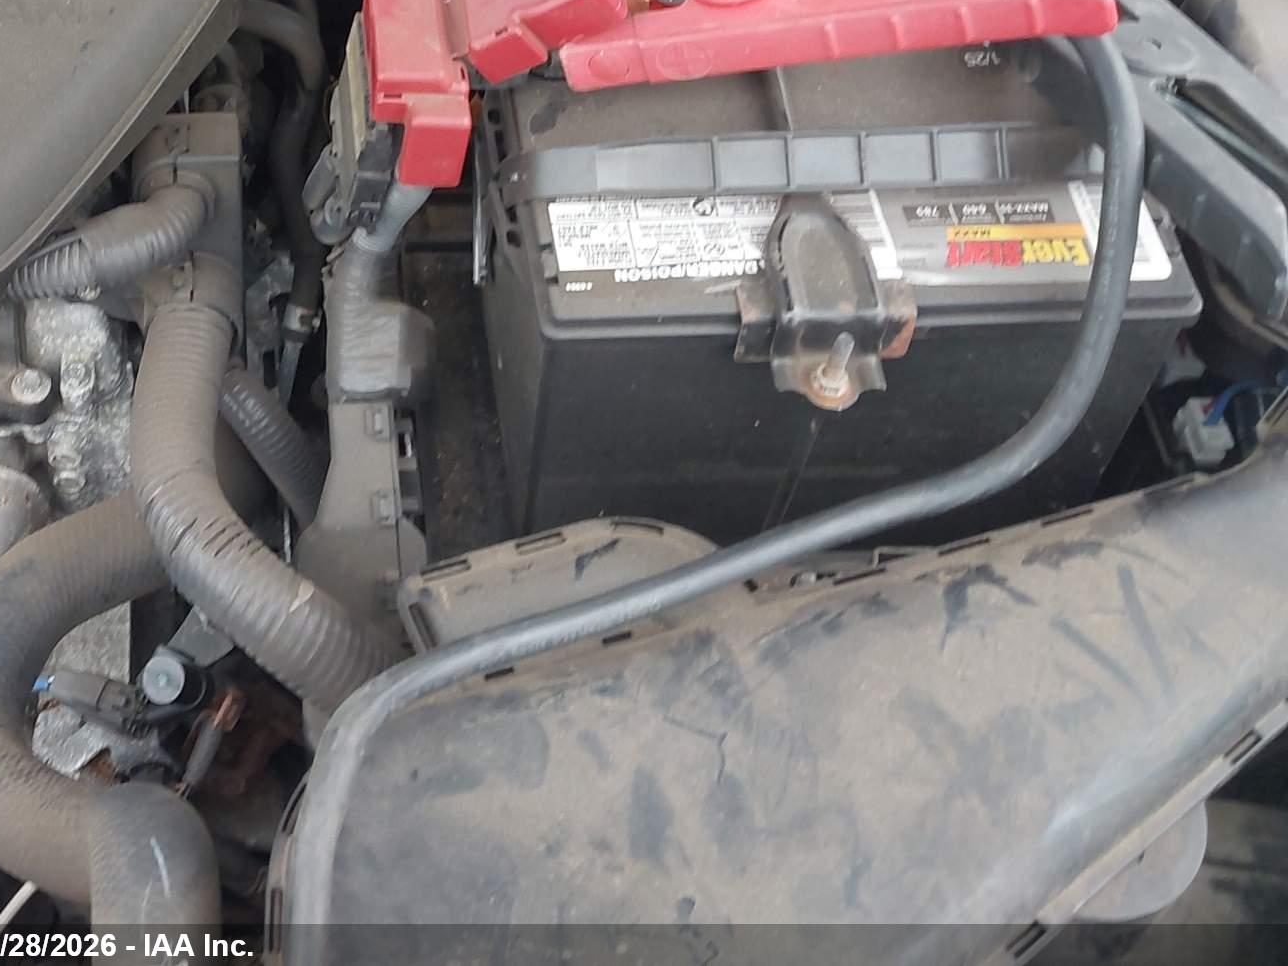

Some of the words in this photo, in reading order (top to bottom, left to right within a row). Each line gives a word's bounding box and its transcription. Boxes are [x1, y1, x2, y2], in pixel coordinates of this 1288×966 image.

[963, 50, 1001, 68] 1/25
[946, 238, 1090, 269] EverStart
[614, 260, 758, 283] DANGER/POISON
